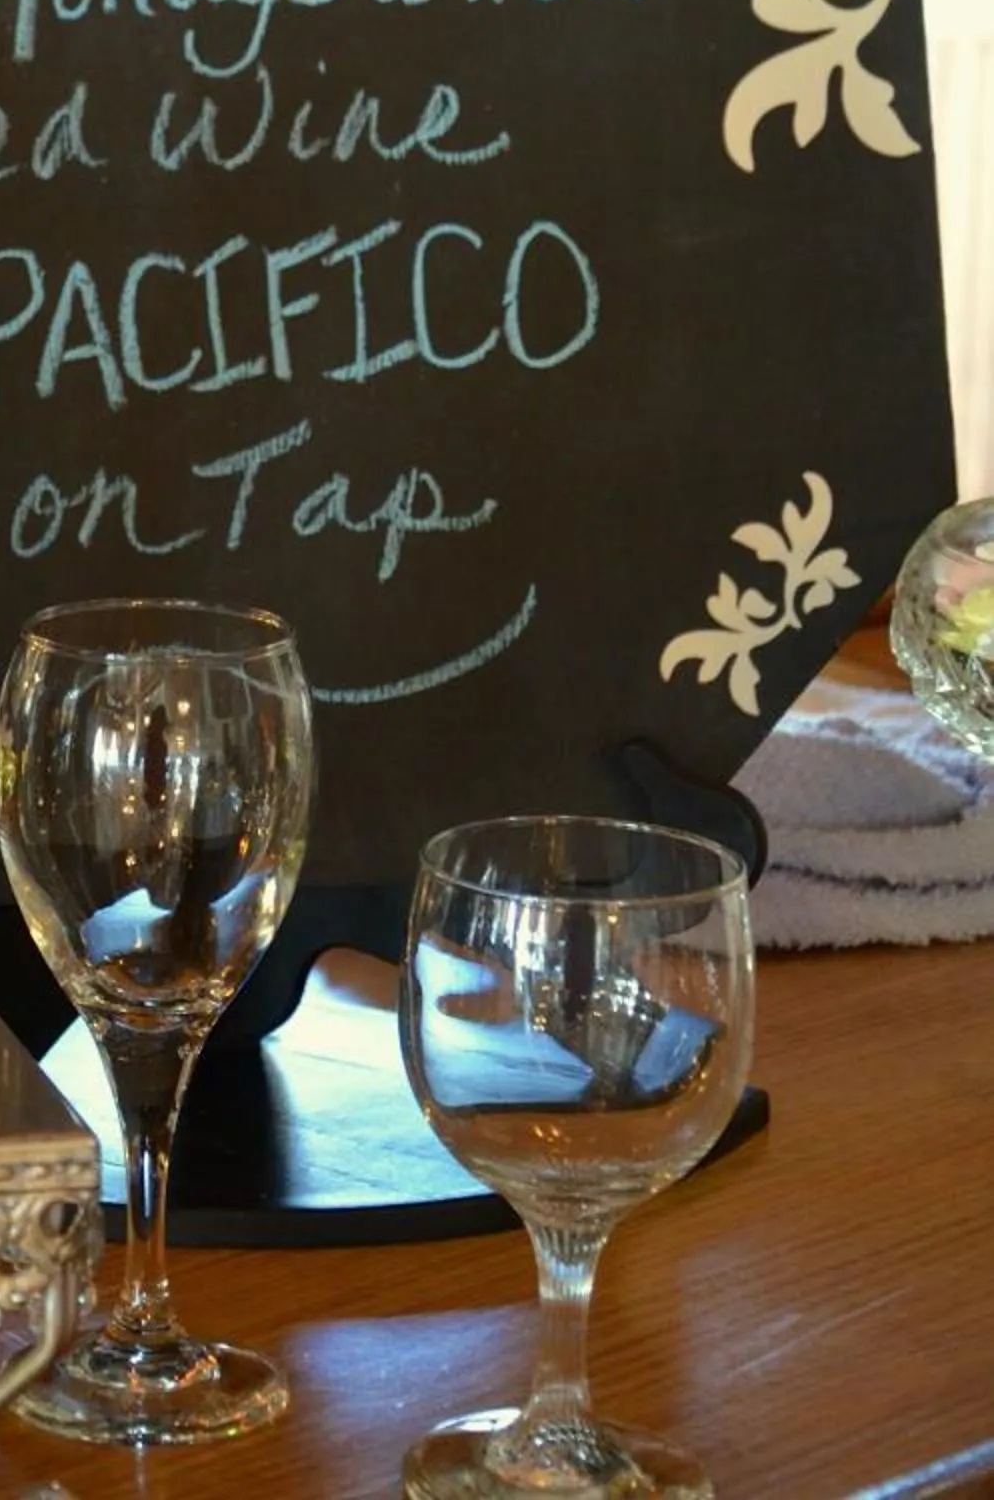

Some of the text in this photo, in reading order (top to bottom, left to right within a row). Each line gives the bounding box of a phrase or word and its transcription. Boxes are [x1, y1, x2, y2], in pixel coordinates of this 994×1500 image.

[148, 58, 512, 172] Wine
[8, 418, 500, 584] on Tap
